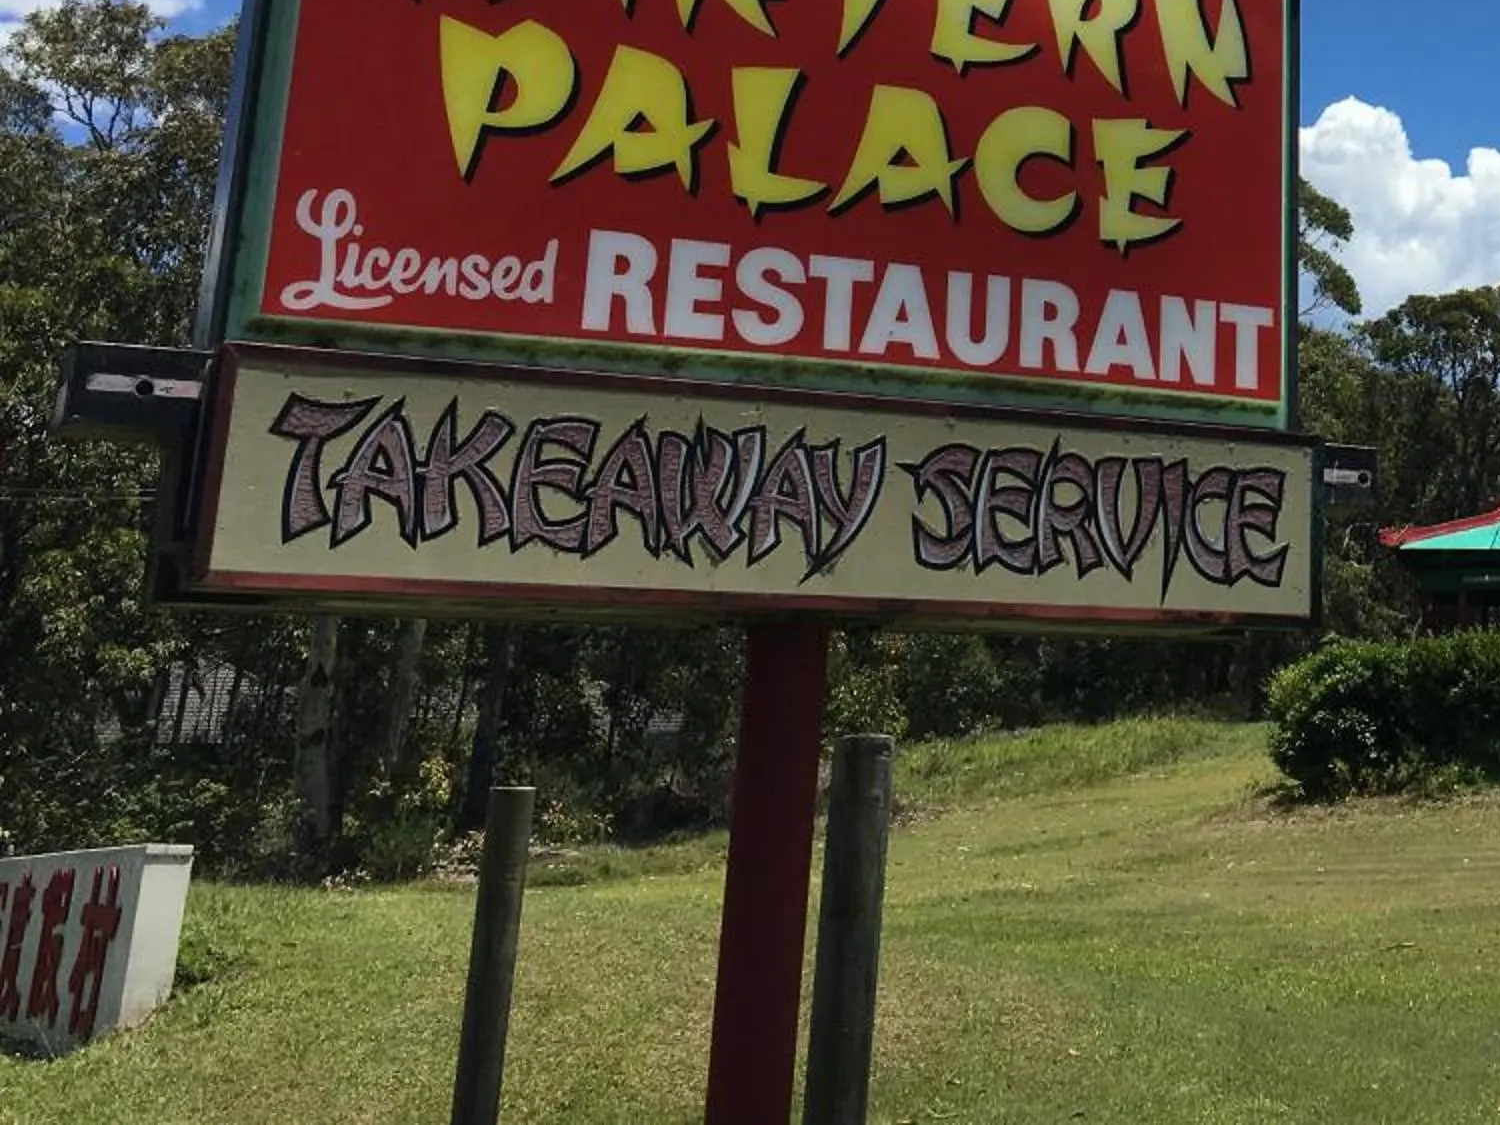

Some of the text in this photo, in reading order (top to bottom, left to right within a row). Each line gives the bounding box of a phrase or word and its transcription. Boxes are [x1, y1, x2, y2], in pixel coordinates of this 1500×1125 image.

[439, 14, 1190, 256] PALACE
[280, 188, 1275, 391] Licensed RESTAURANT
[269, 392, 1290, 606] TAKEAWAY SERVICE
